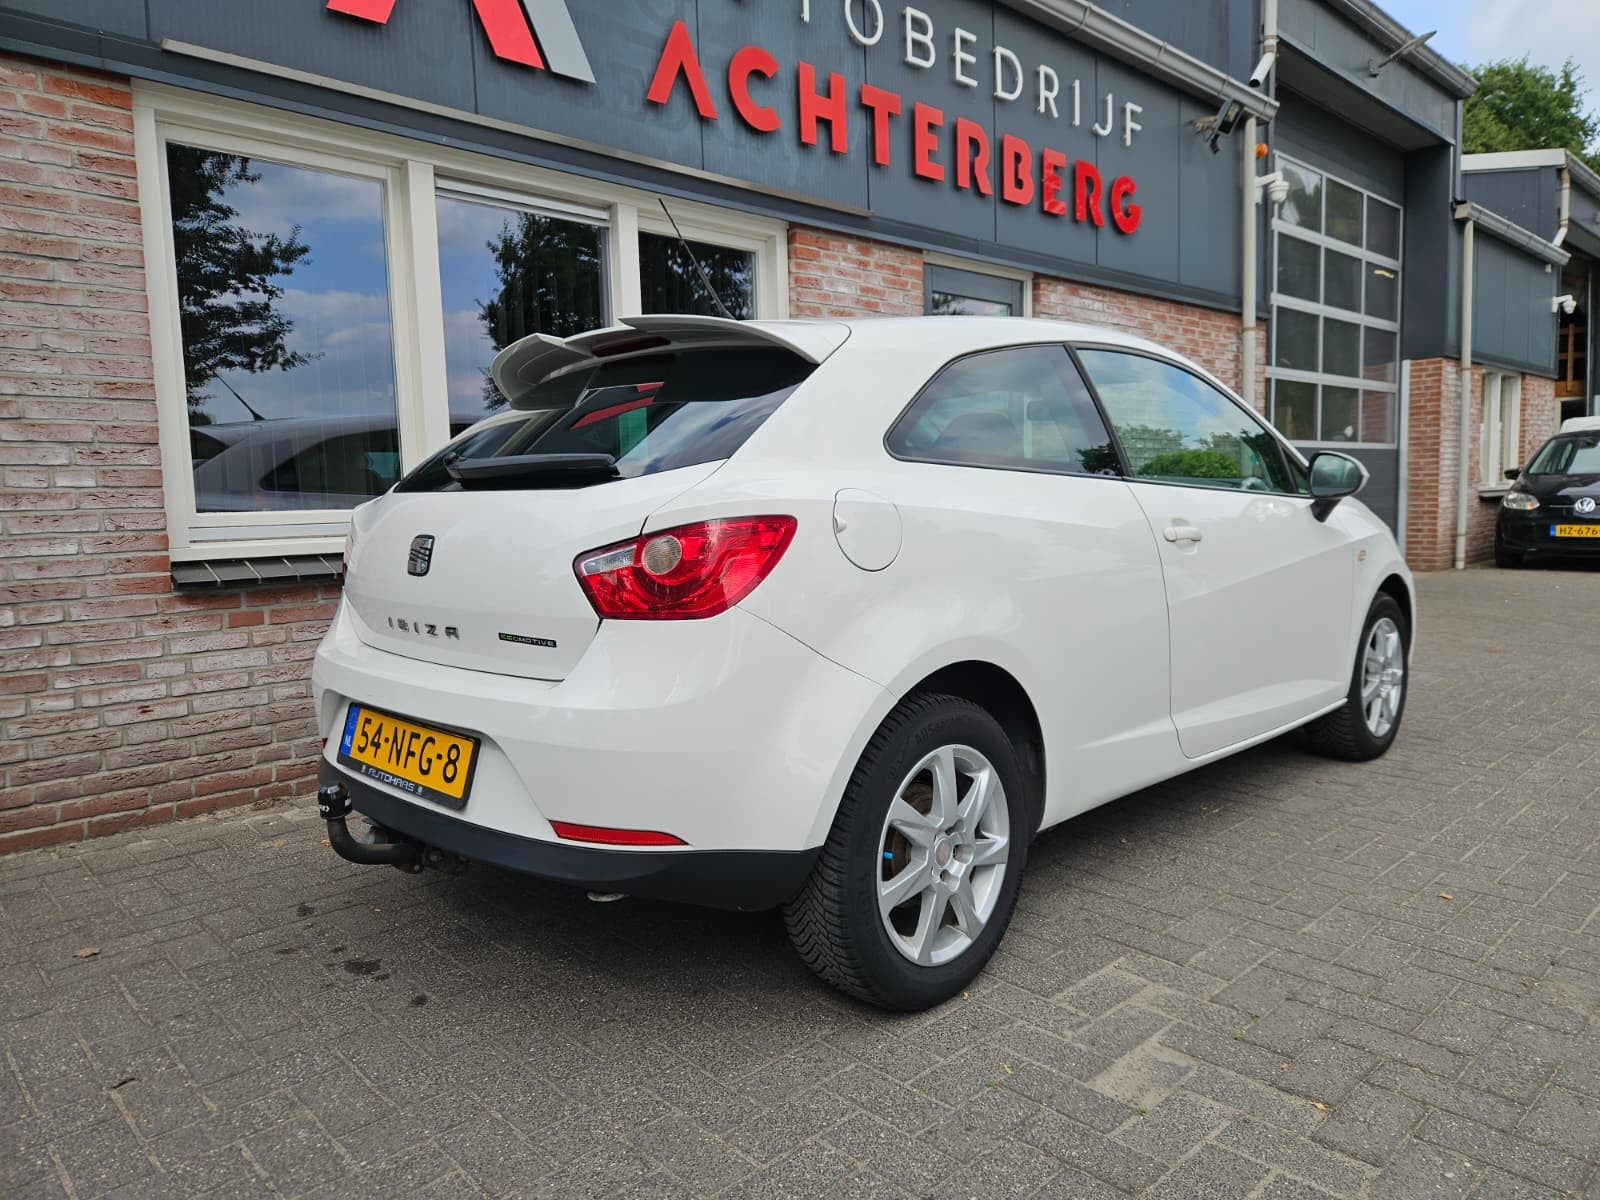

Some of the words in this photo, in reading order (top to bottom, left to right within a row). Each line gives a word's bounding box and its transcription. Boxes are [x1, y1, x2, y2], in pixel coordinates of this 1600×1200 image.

[647, 20, 1142, 234] ACHTERBERG
[387, 616, 460, 641] IBIZA
[499, 633, 556, 647] ECOMOTIVE
[344, 735, 352, 747] NL
[357, 717, 461, 784] 54-NFG-8
